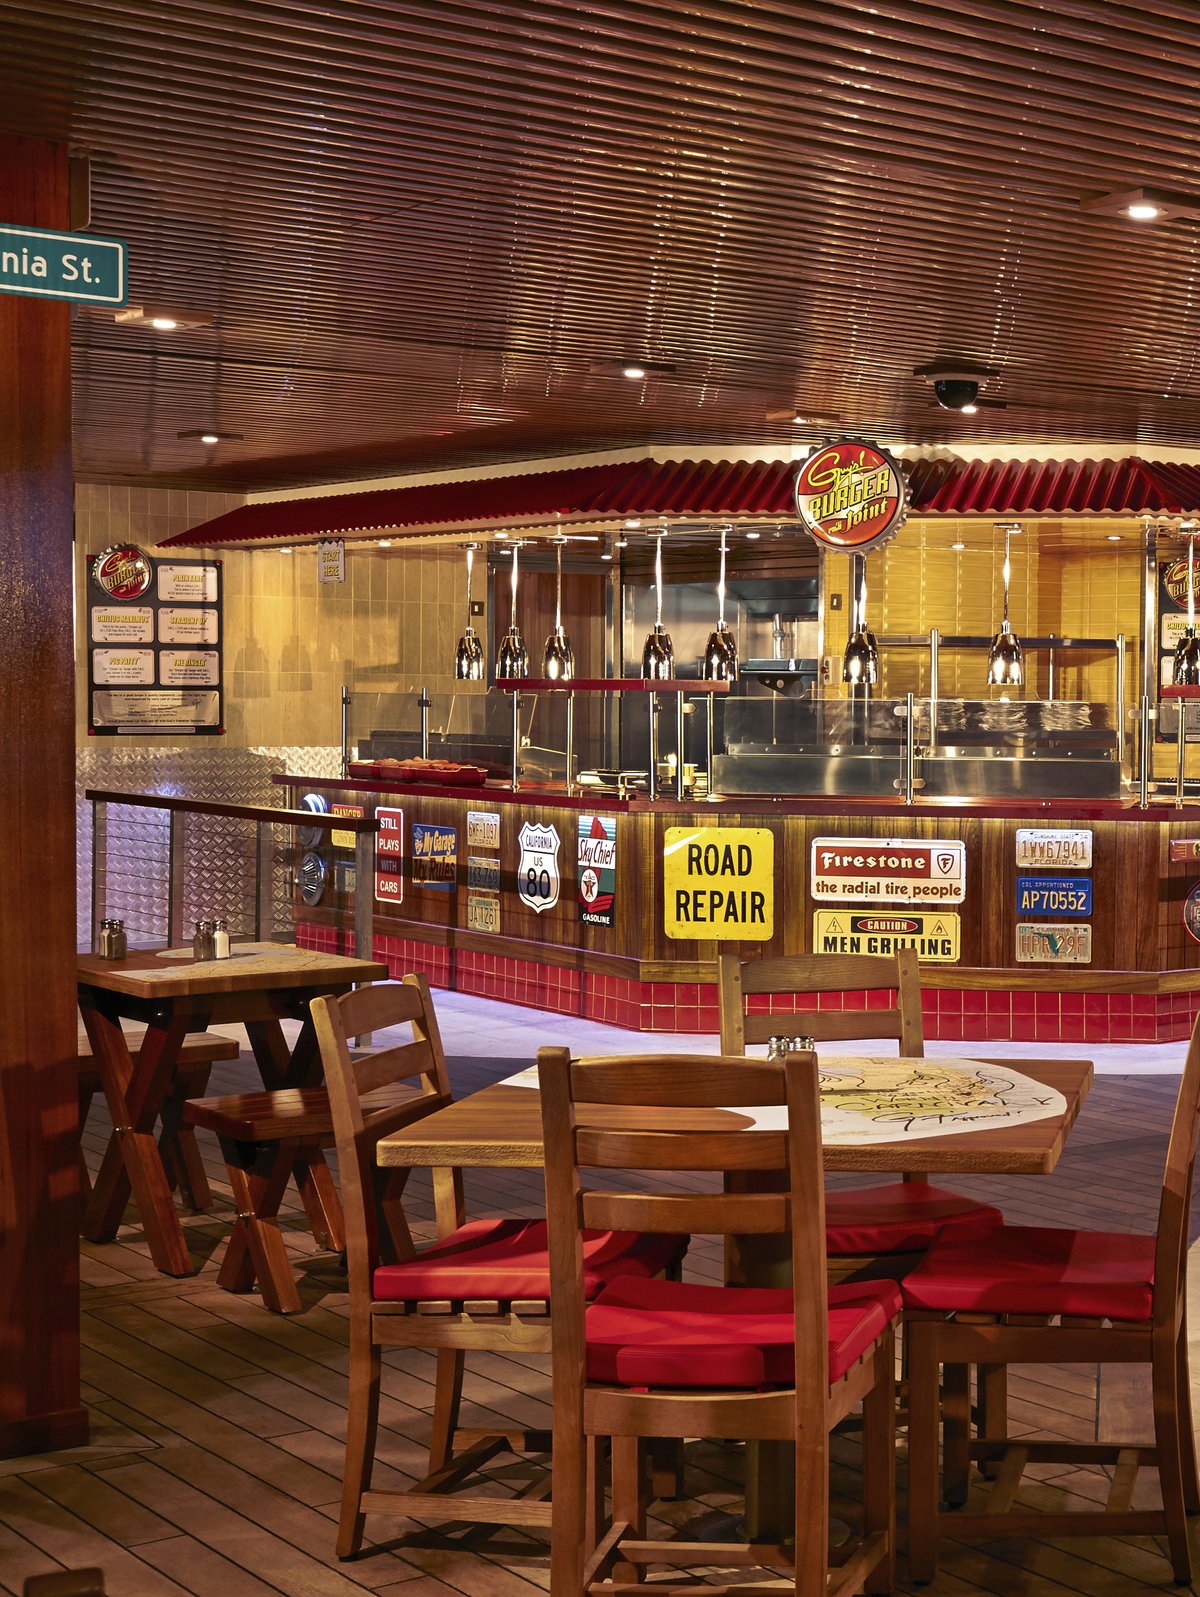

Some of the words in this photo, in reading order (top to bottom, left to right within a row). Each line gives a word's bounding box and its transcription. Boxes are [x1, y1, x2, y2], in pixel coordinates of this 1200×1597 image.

[1, 248, 47, 278] nia
[61, 254, 101, 284] St.
[808, 467, 890, 524] BURGER
[841, 498, 888, 533] Joint
[322, 551, 340, 563] START
[324, 565, 340, 577] HERE
[380, 817, 399, 830] STILL
[379, 838, 400, 851] PLAYS
[423, 832, 433, 858] My
[434, 831, 455, 857] Garage
[526, 834, 552, 851] CALIFORNIA
[1022, 840, 1087, 860] 1WW67941
[534, 856, 543, 867] US
[578, 839, 592, 867] Sky
[593, 840, 616, 866] Chief
[688, 843, 752, 877] ROAD
[820, 851, 926, 870] Firestone
[1034, 858, 1074, 866] FLORIDA
[381, 860, 397, 871] WITH
[380, 880, 398, 894] CARS
[526, 868, 550, 899] 80
[815, 881, 838, 894] the
[842, 881, 880, 895] radial
[885, 882, 908, 896] tire
[912, 883, 961, 899] people
[676, 890, 765, 924] REPAIR
[1022, 890, 1087, 911] AP70552
[583, 913, 611, 924] GASOLINE
[867, 920, 908, 932] CAUTION
[823, 936, 862, 954] MEN
